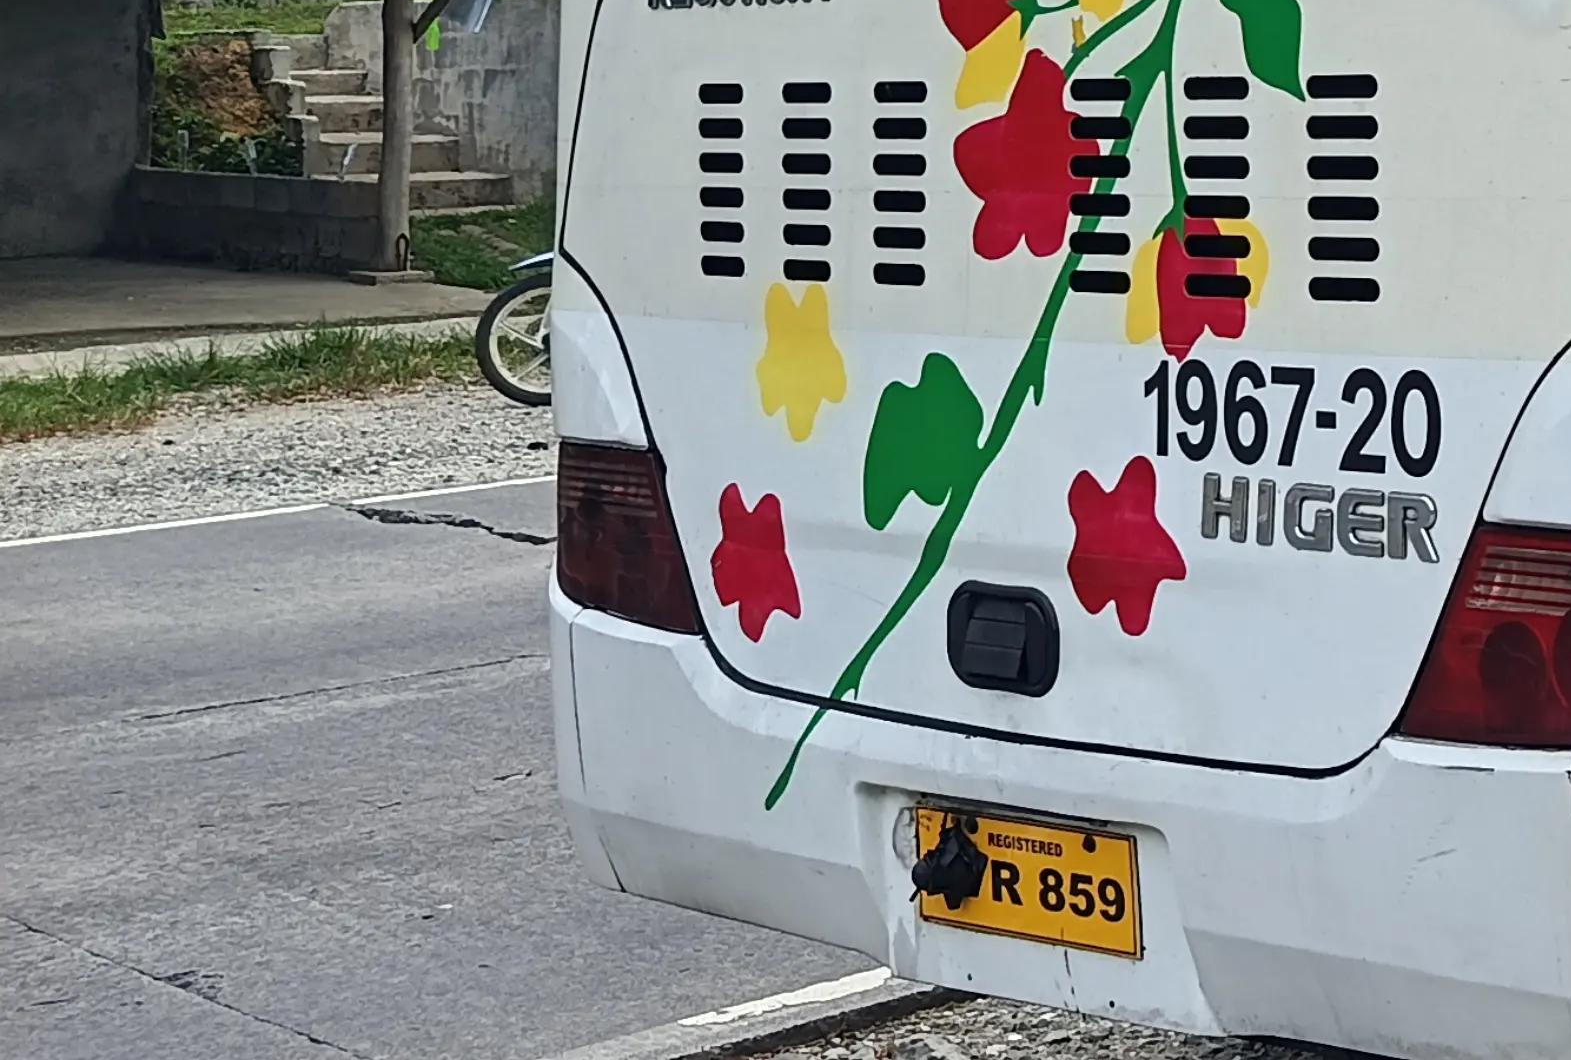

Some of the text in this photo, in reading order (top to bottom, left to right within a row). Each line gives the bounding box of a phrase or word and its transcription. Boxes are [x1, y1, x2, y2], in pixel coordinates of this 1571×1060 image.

[1144, 359, 1441, 477] 1967-20
[1201, 472, 1440, 563] HIGER
[987, 832, 1063, 857] REGISTERED
[1039, 868, 1126, 922] 859
